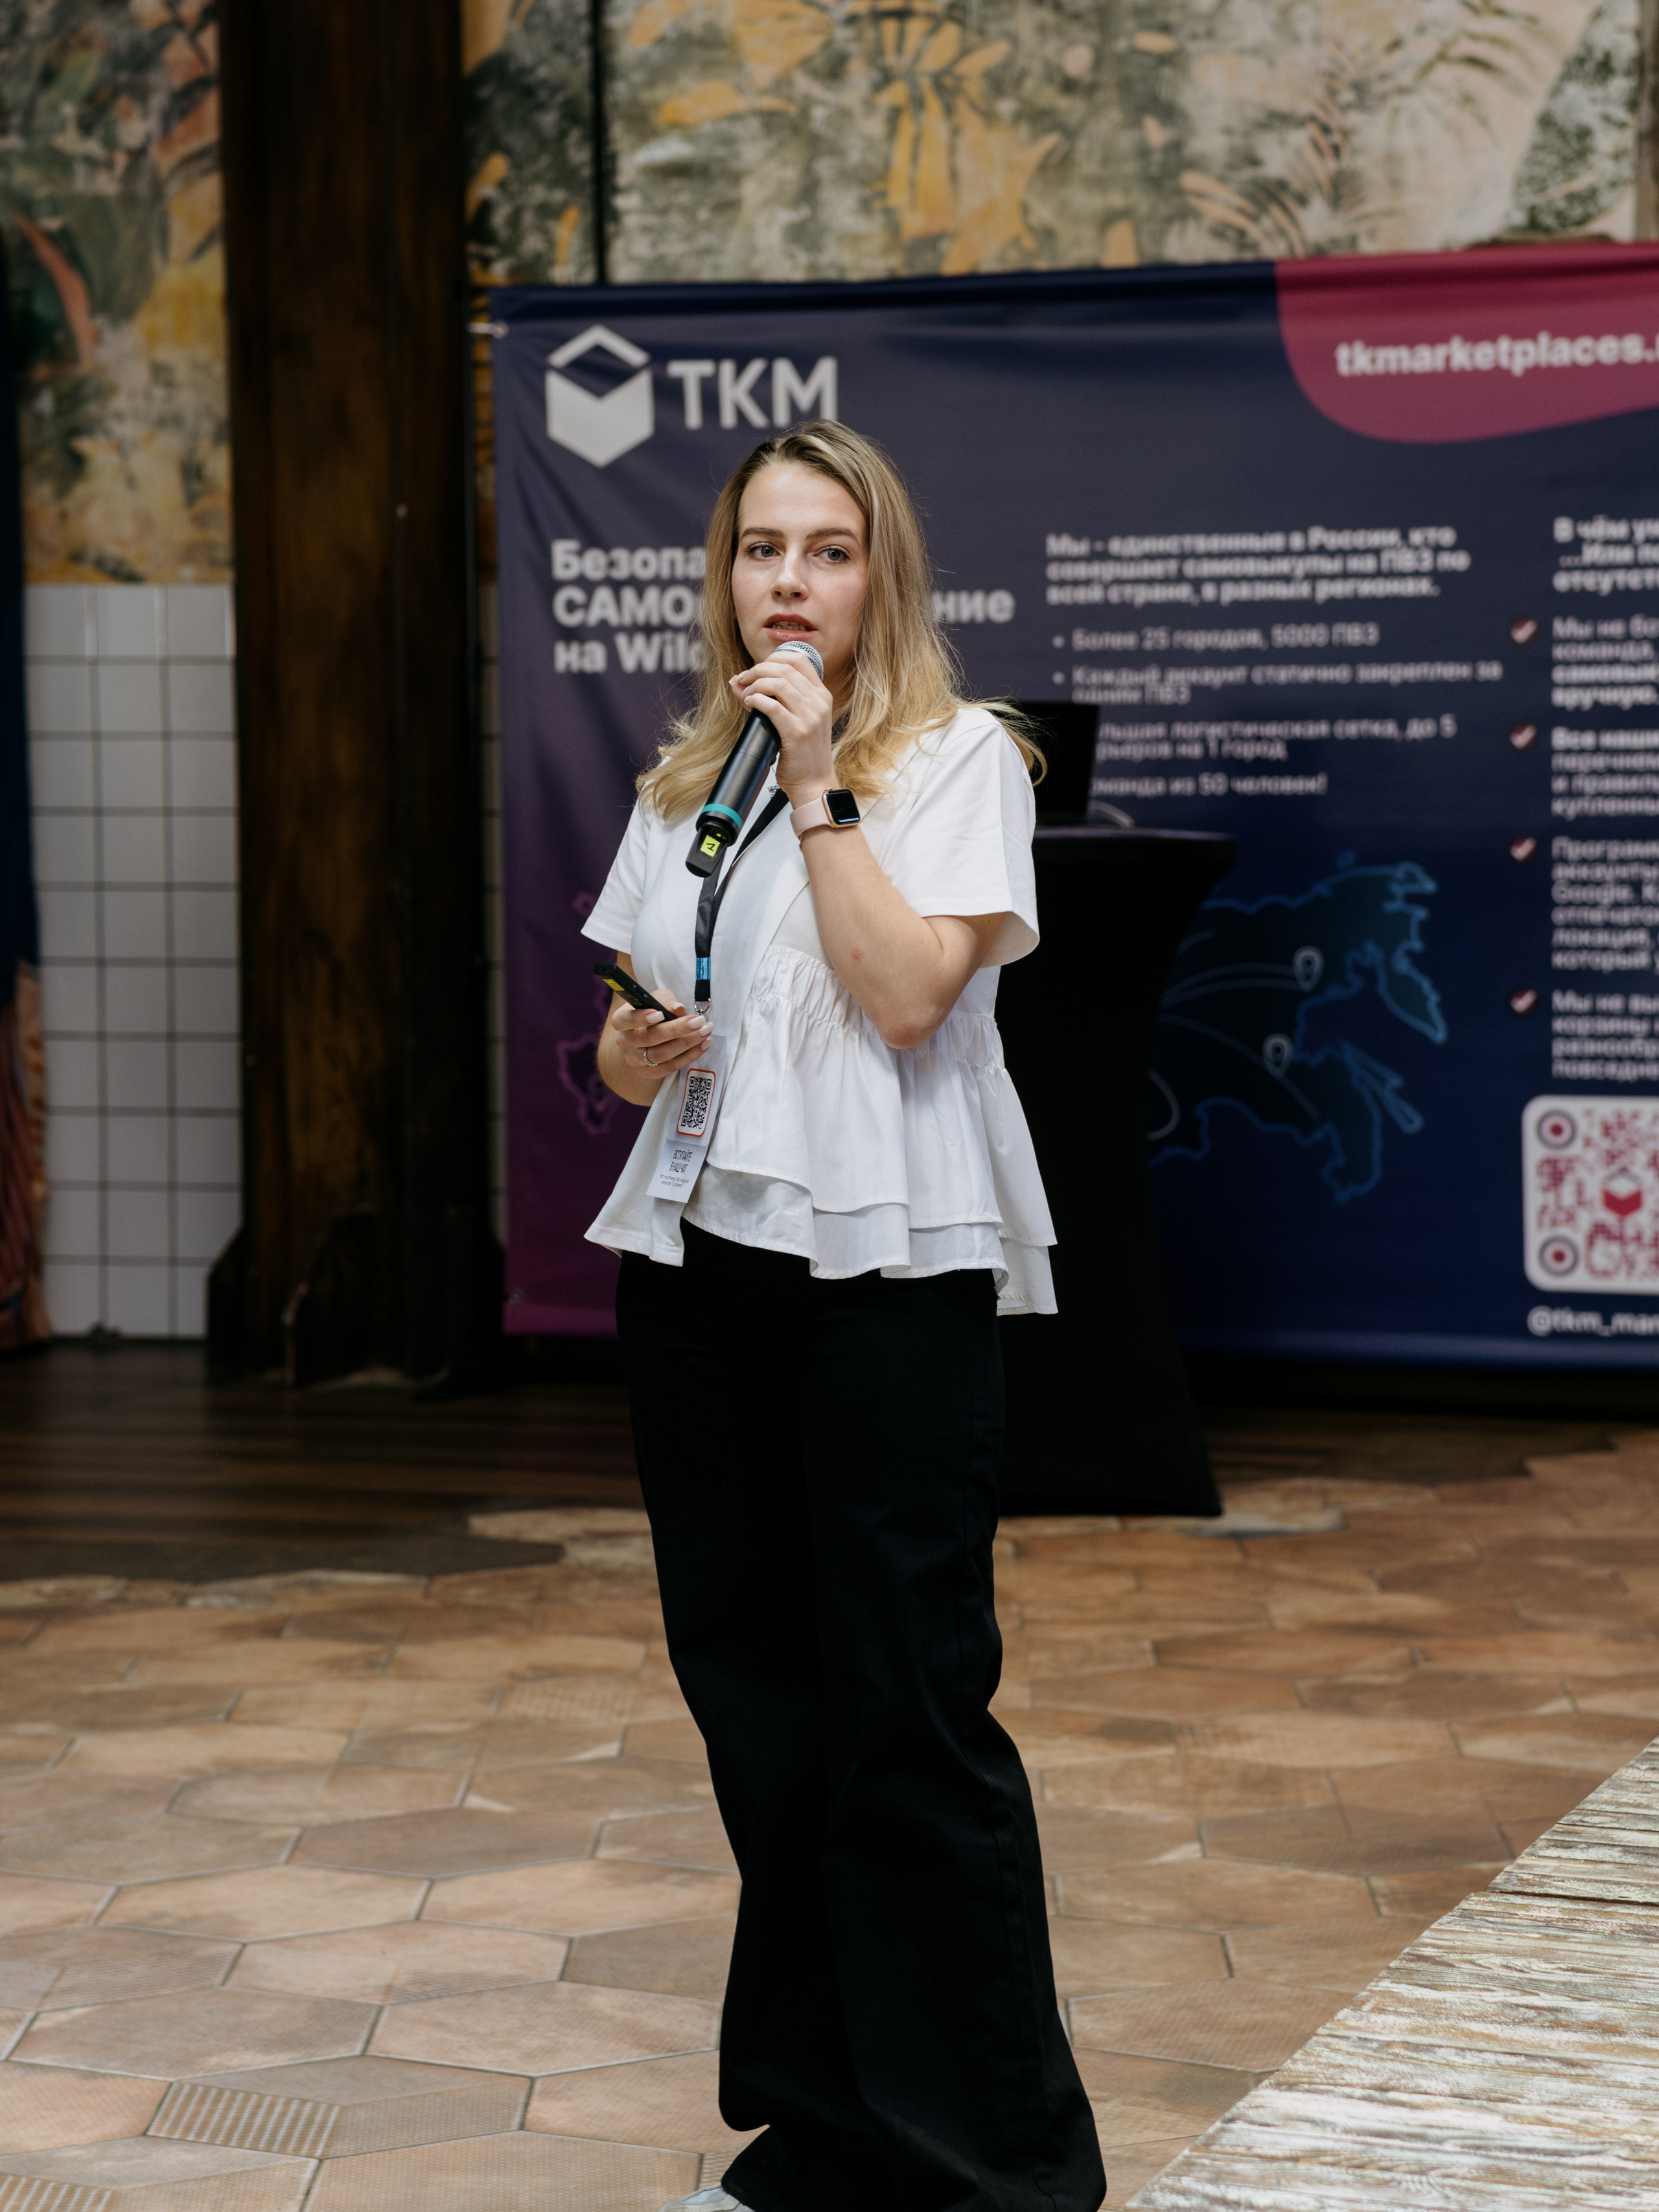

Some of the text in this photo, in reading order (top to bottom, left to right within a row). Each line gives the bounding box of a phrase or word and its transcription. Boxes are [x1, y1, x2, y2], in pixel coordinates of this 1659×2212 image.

[1335, 331, 1659, 378] tkmarketplaces.
[1046, 532, 1089, 557] Мы
[1108, 531, 1286, 558] единственные
[1289, 531, 1305, 552] в
[1308, 526, 1406, 552] России,
[1408, 526, 1456, 548] кто
[1046, 558, 1180, 583] совершает
[1346, 553, 1378, 574] на
[1380, 548, 1434, 574] ПВЗ
[1437, 550, 1470, 571] по
[931, 588, 1015, 625] ние
[1201, 582, 1218, 603] в
[1072, 628, 1139, 651] Более
[1271, 623, 1329, 647] 5000
[1332, 622, 1380, 646] ПВЗ
[554, 639, 609, 675] на
[1071, 663, 1162, 689] Каждый
[1164, 665, 1249, 689] аккаунт
[1251, 664, 1352, 686] статично
[1144, 682, 1191, 705] ПВЗ
[1096, 721, 1168, 742] льшая
[1405, 717, 1437, 741] до
[1440, 714, 1457, 738] 5
